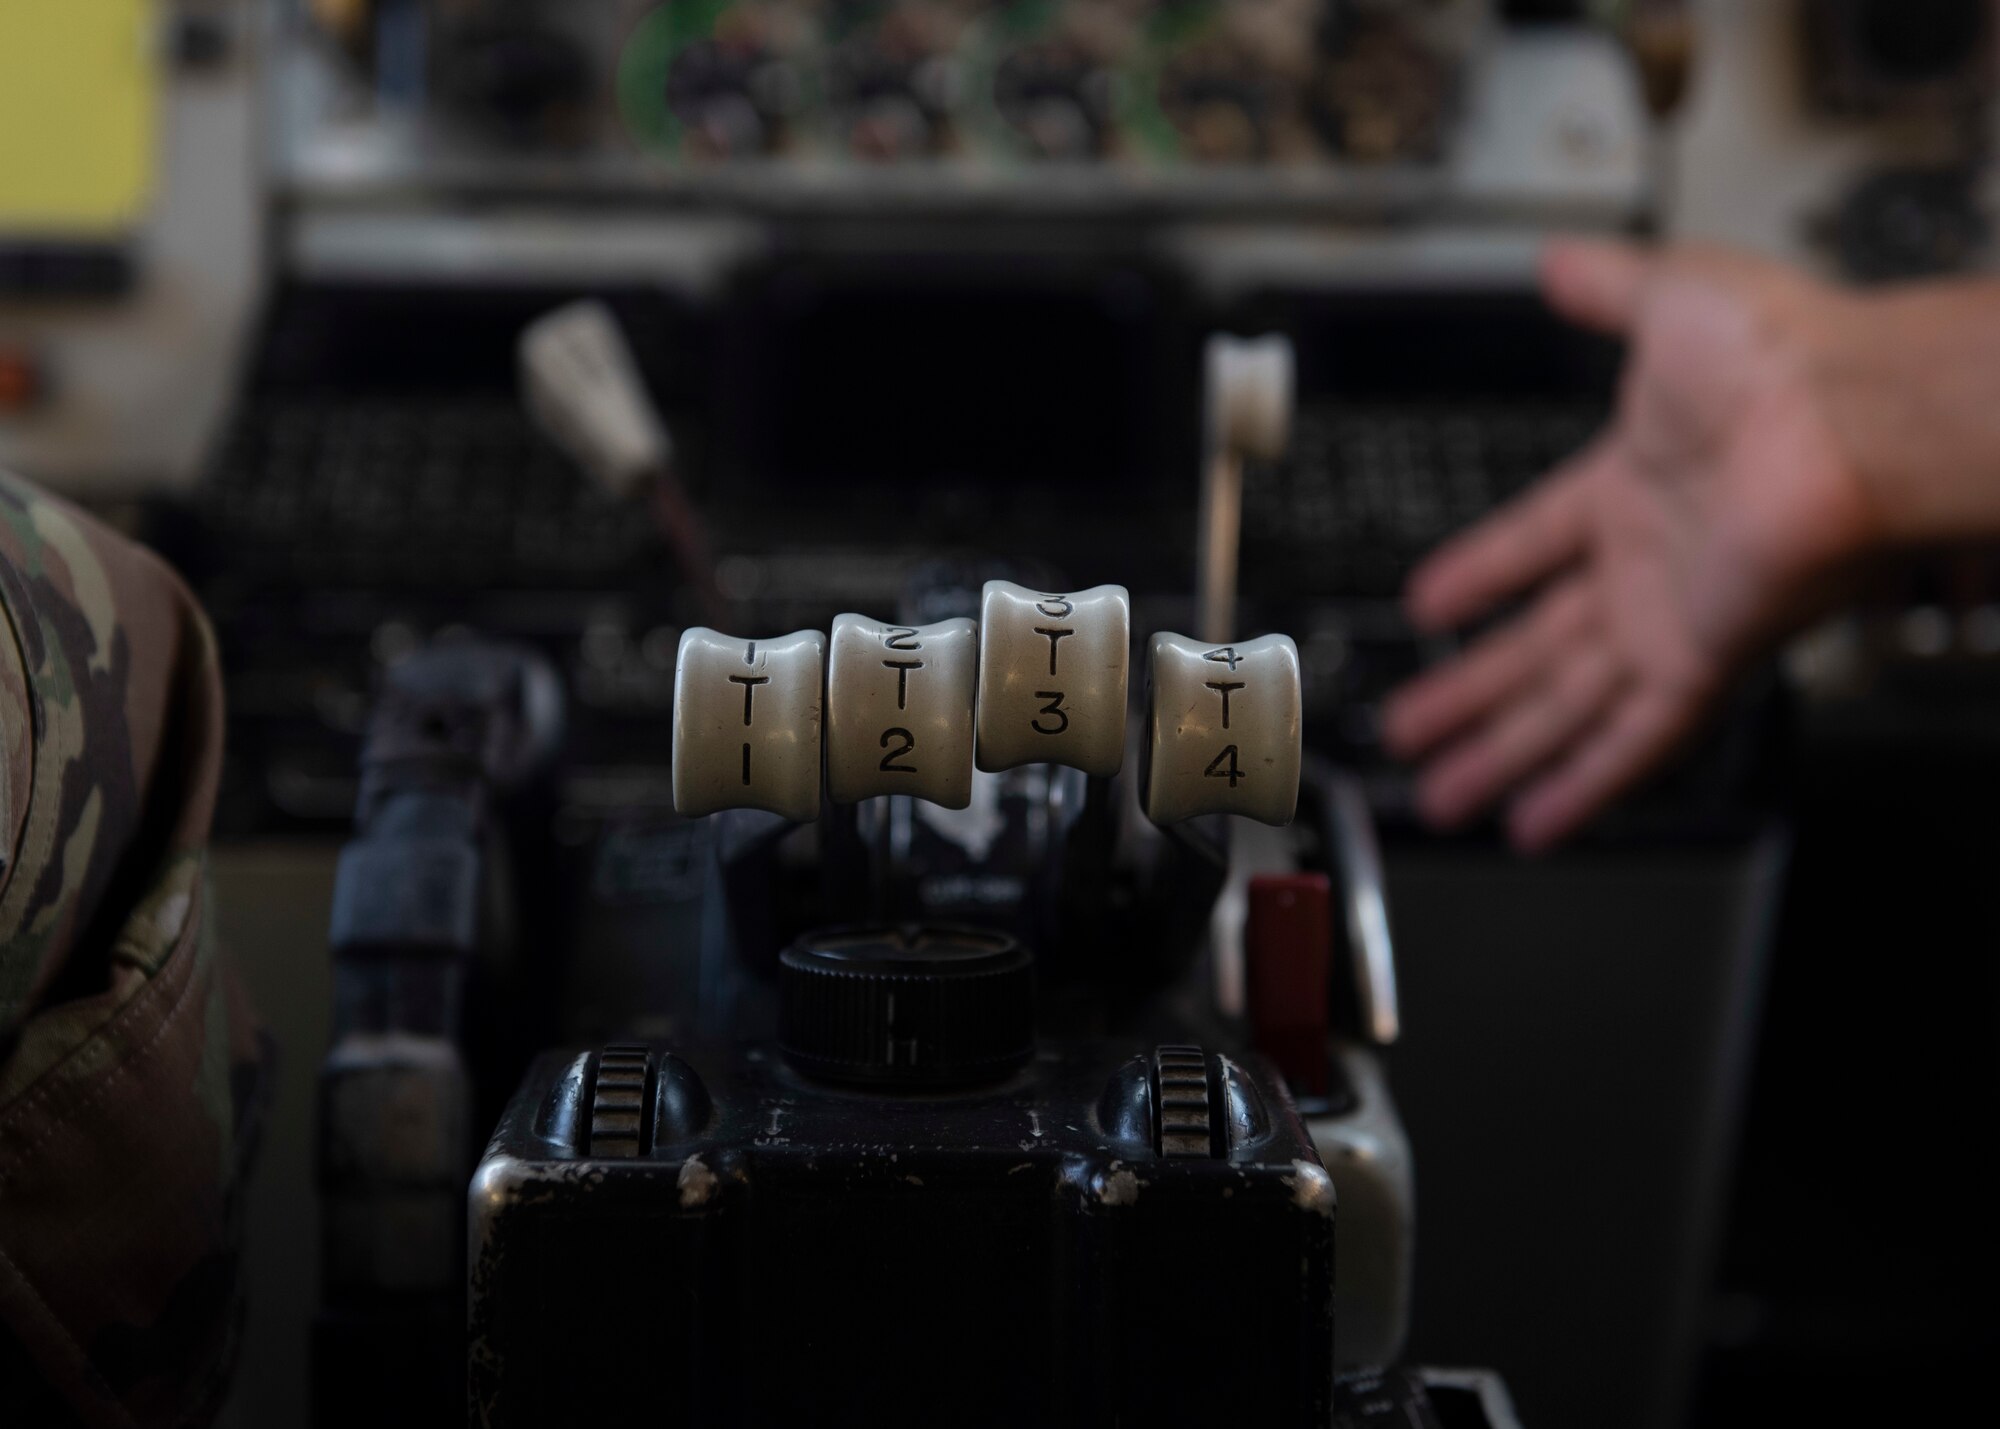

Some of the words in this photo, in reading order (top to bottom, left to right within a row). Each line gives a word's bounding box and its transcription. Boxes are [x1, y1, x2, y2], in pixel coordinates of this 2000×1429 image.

[1036, 593, 1074, 617] 3
[885, 627, 922, 650] 2
[1034, 626, 1074, 676] T
[1203, 647, 1244, 671] 4
[728, 674, 770, 726] T
[882, 660, 924, 710] T
[1205, 681, 1247, 730] T
[1031, 691, 1069, 735] 3
[742, 742, 751, 786] 1
[879, 727, 918, 773] 2
[1204, 744, 1246, 788] 4
